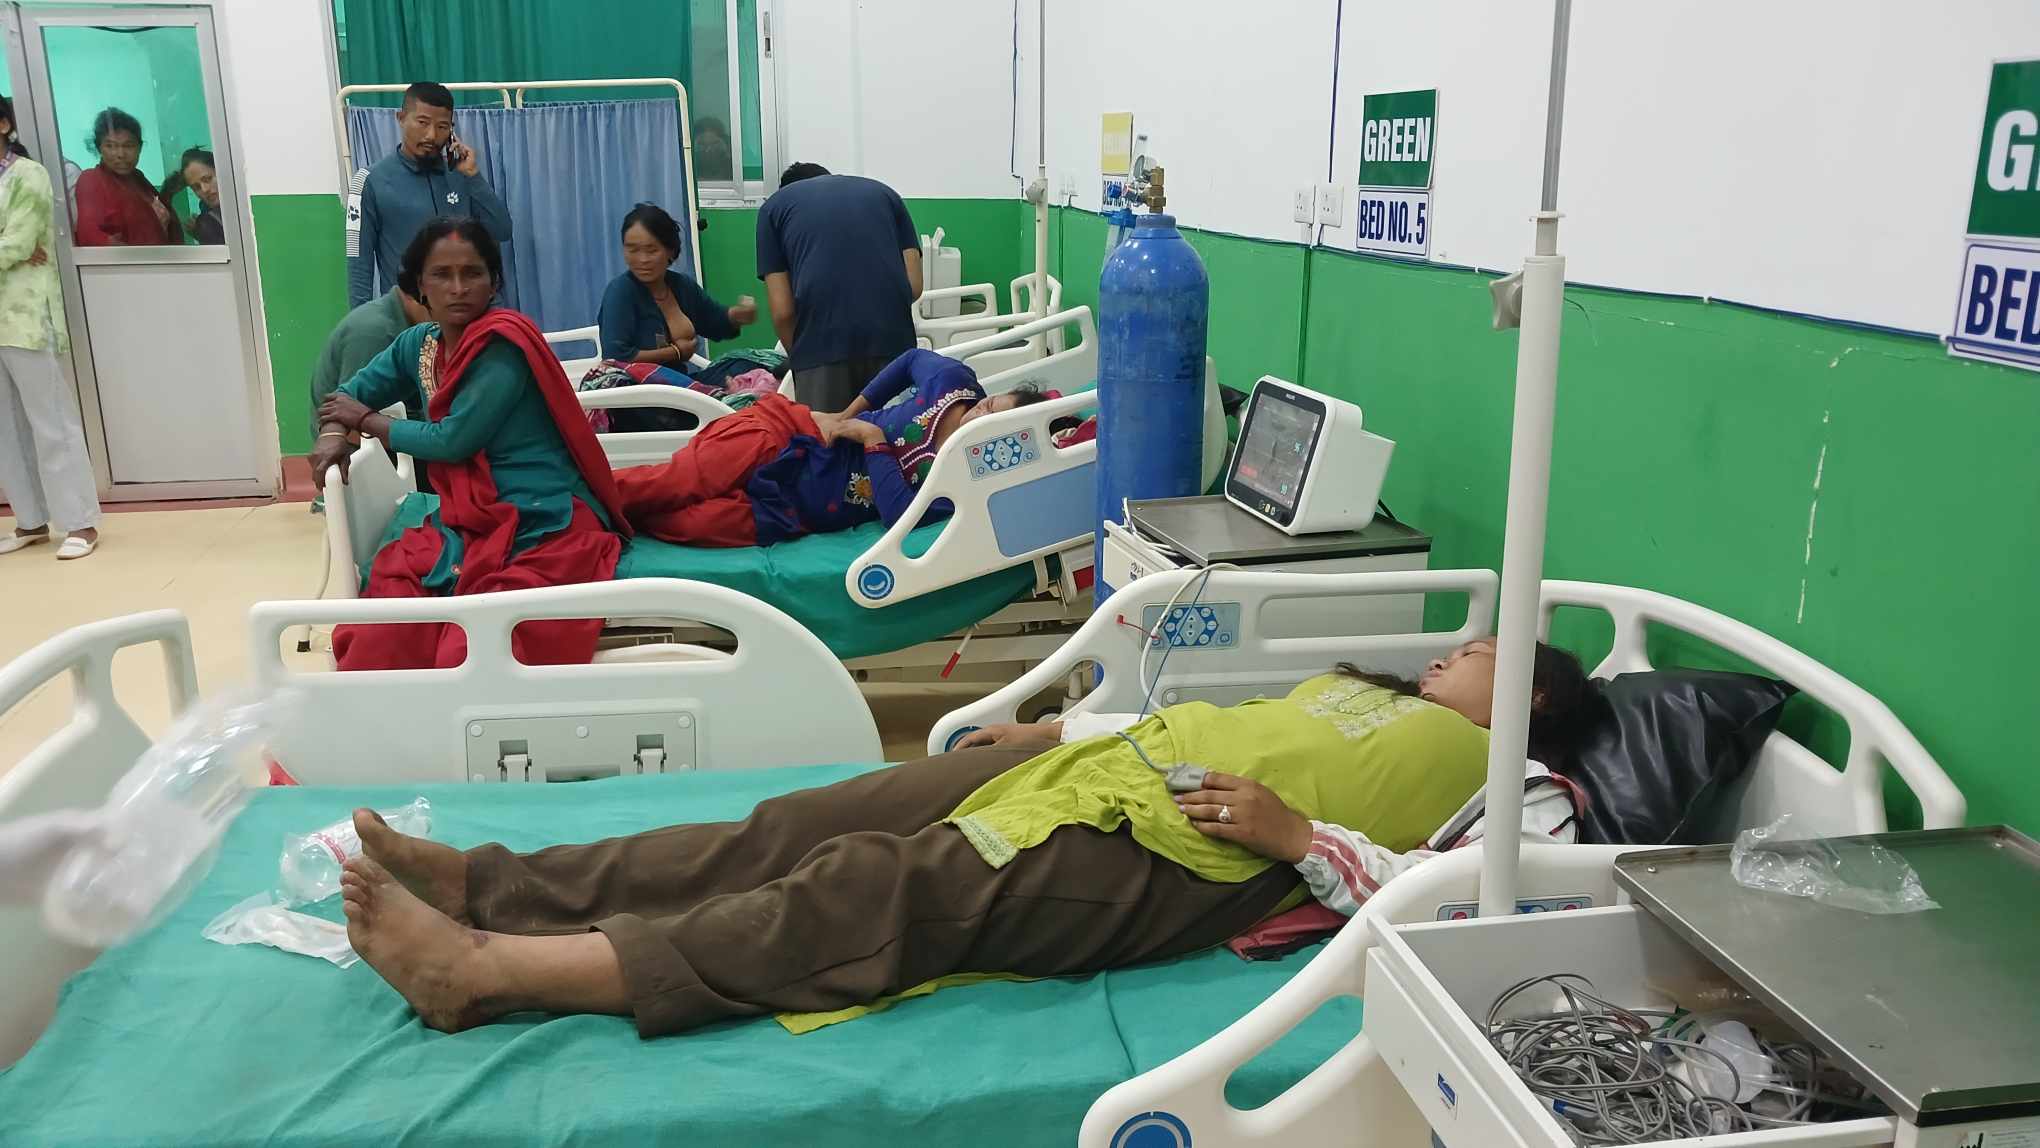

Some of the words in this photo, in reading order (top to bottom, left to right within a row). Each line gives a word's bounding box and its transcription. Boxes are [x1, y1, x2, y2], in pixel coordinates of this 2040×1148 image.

[1364, 117, 1431, 161] GREEN
[1987, 109, 2040, 192] G
[1360, 200, 1385, 240] BED
[1387, 201, 1412, 243] NO.
[1416, 202, 1426, 245] 5
